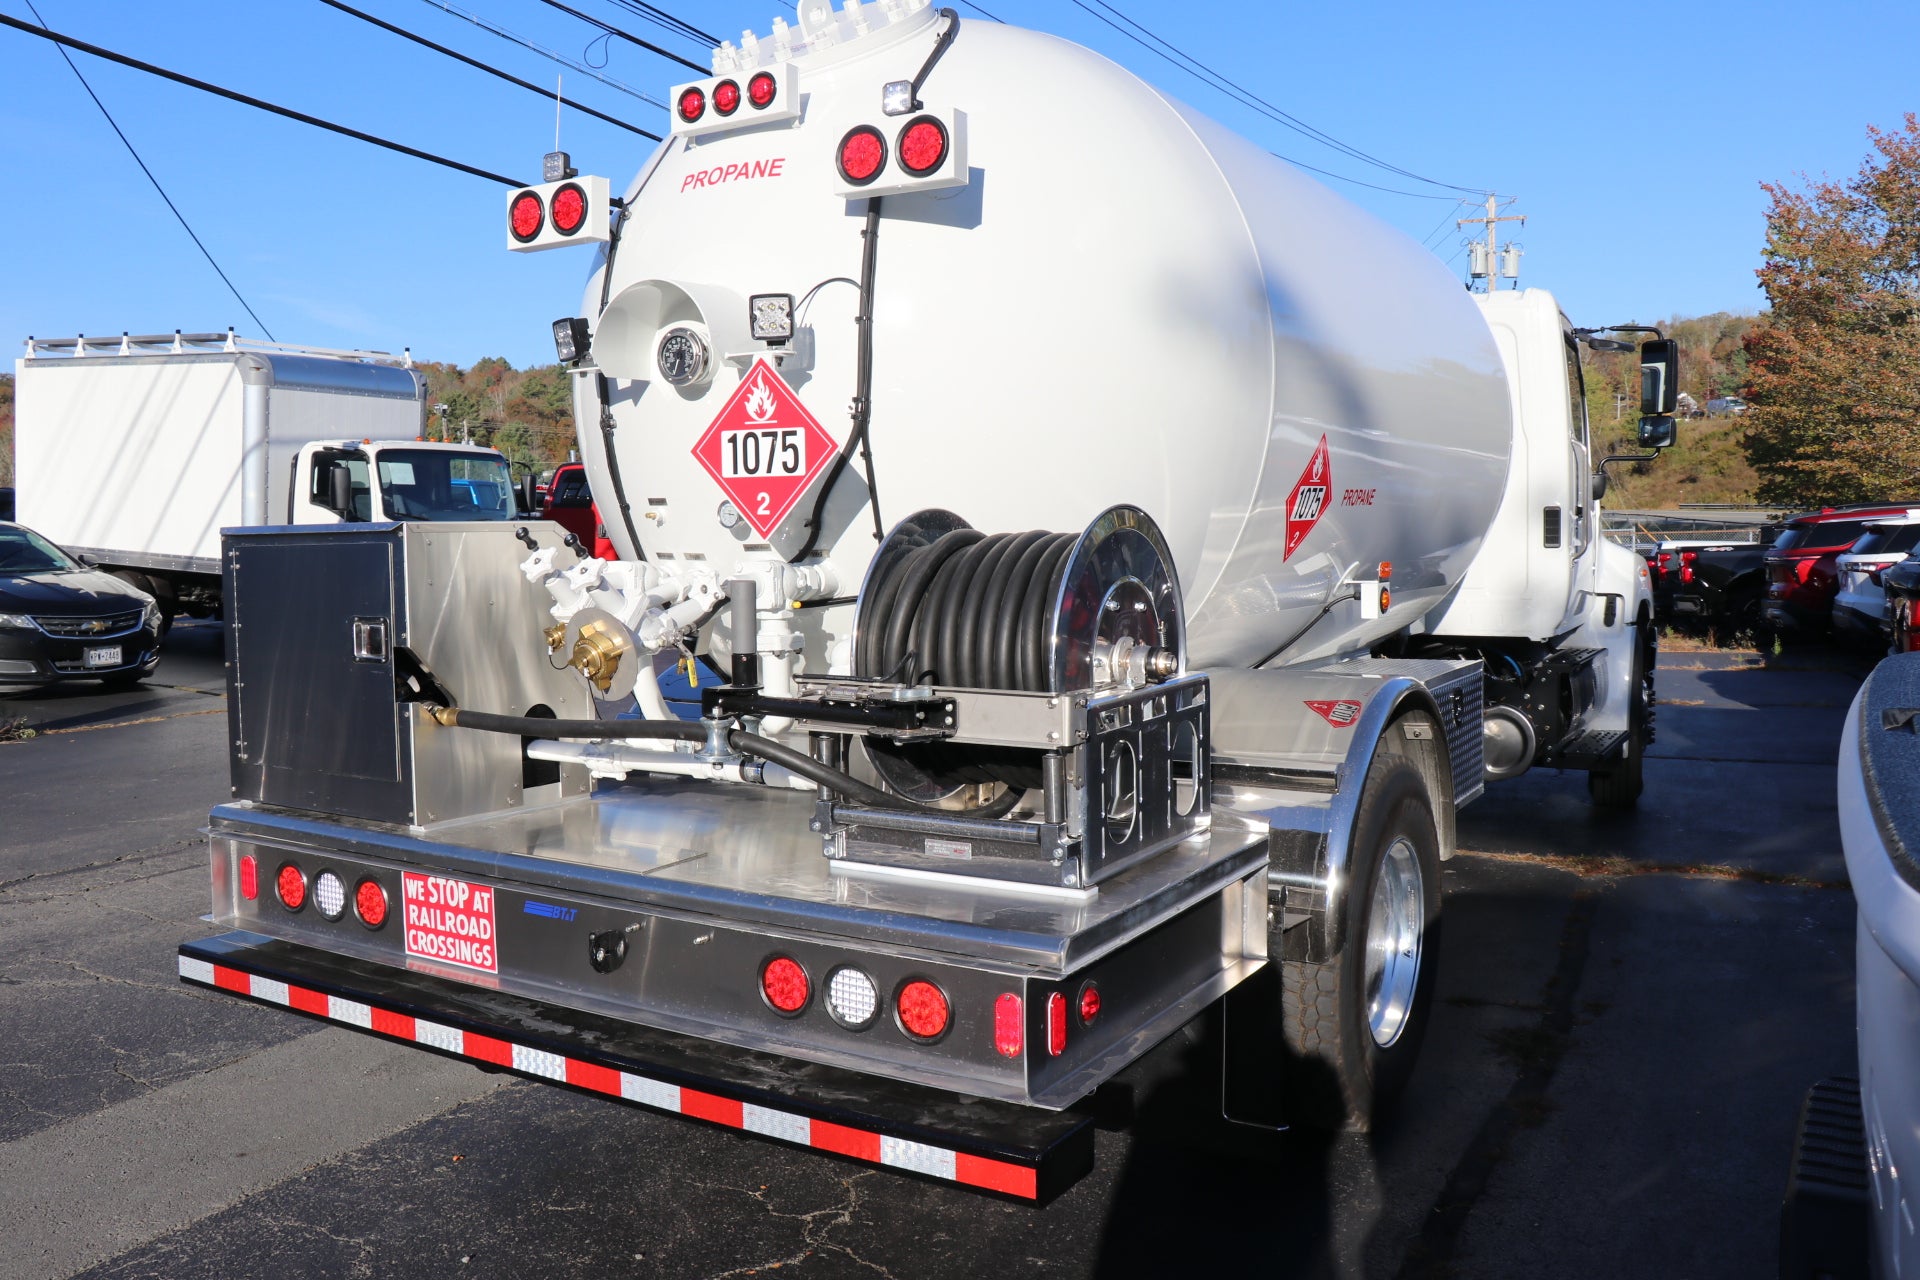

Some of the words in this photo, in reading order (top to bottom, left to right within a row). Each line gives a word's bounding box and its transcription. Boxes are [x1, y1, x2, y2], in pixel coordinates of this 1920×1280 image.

[681, 158, 785, 193] PROPANE
[727, 430, 799, 475] 1075
[756, 491, 770, 515] 2
[1294, 487, 1324, 519] 1075
[1341, 489, 1376, 506] PROPANE
[1289, 531, 1300, 547] 2
[406, 878, 425, 901] WE
[427, 877, 469, 909] STOP
[473, 891, 491, 913] AT
[408, 904, 492, 940] RAILROAD
[408, 929, 493, 967] CROSSINGS
